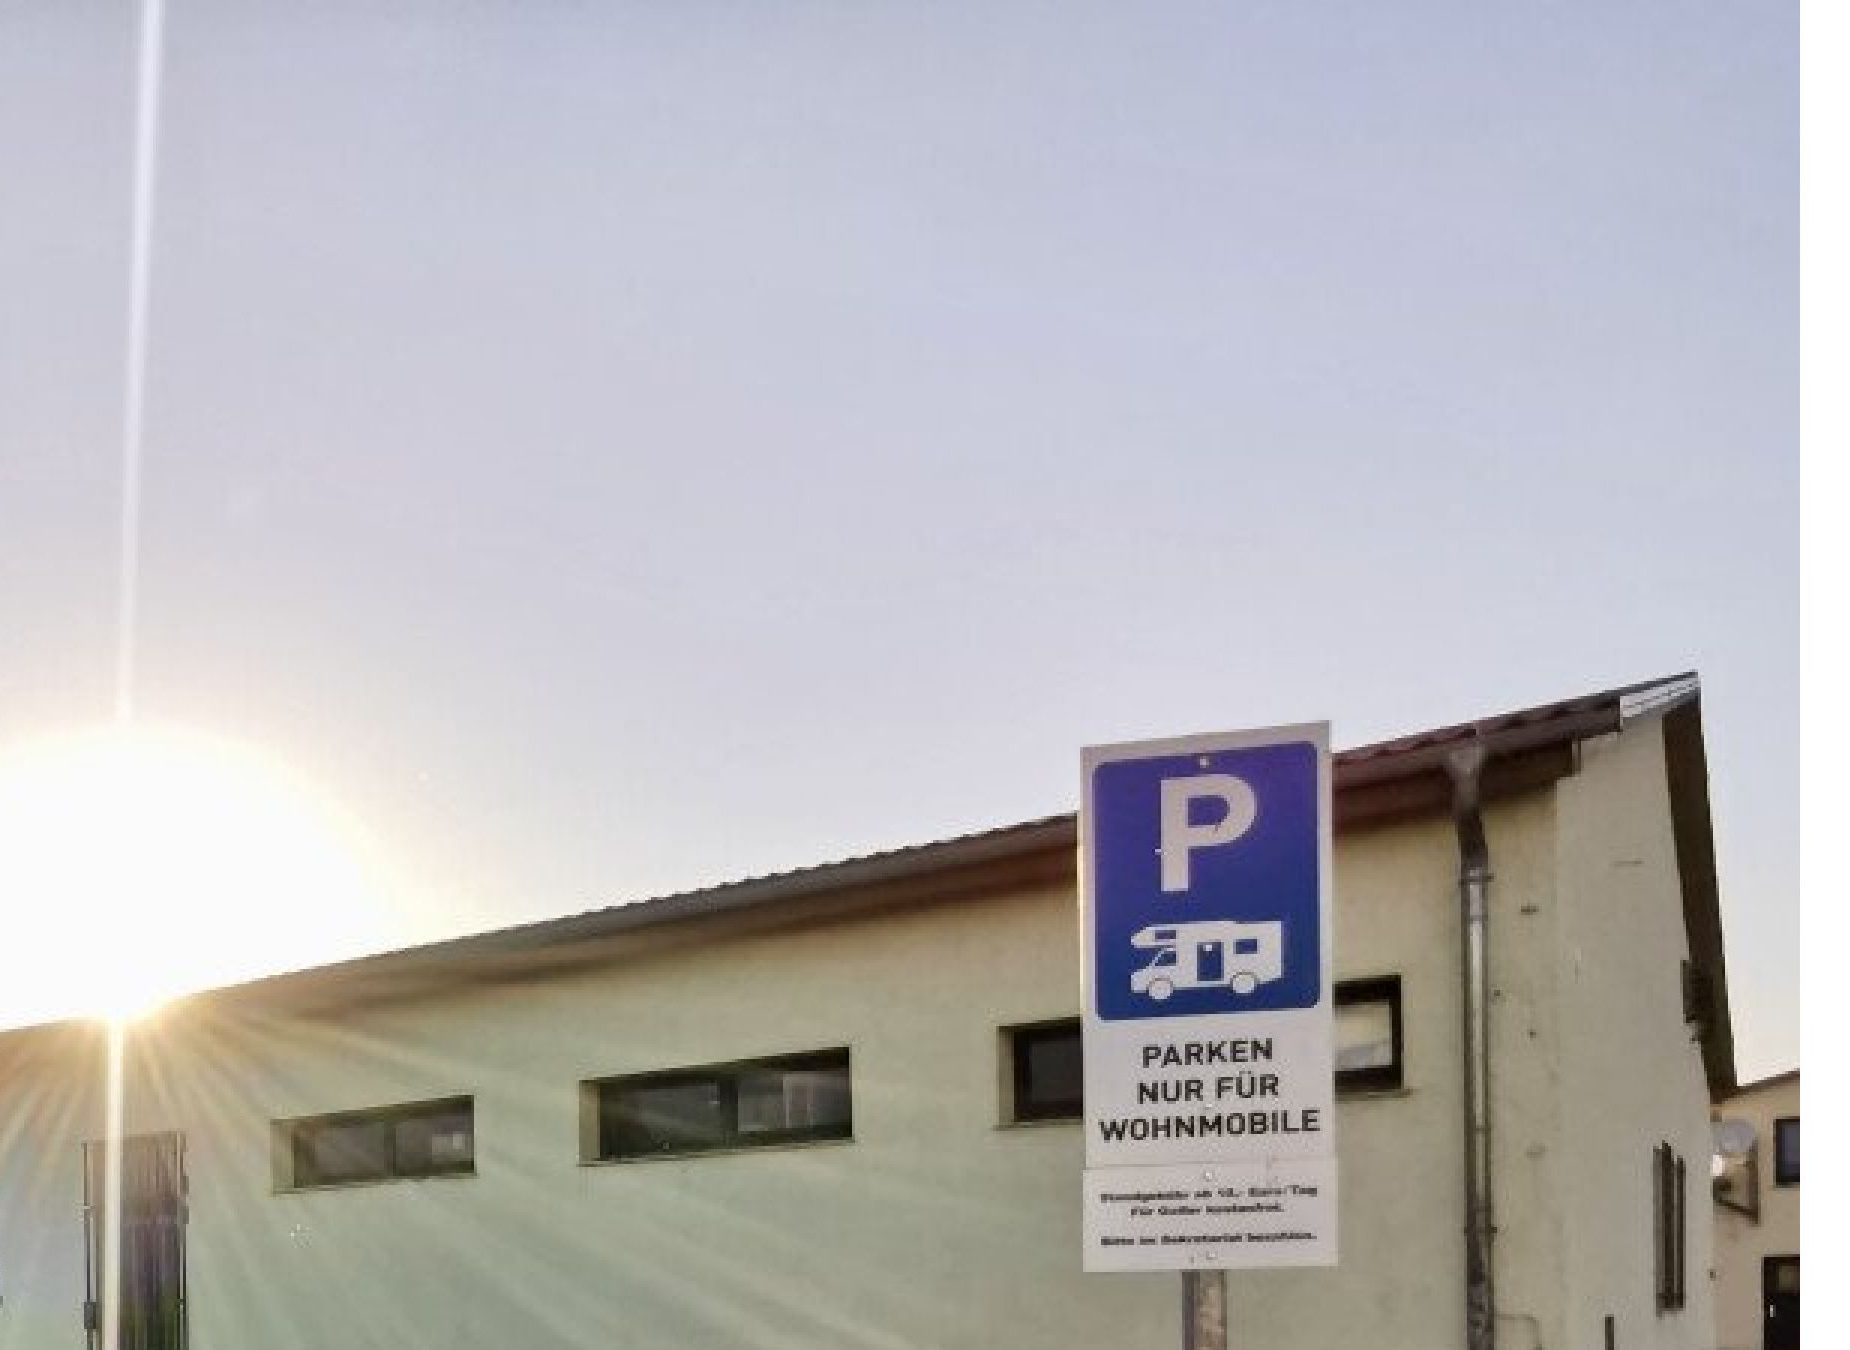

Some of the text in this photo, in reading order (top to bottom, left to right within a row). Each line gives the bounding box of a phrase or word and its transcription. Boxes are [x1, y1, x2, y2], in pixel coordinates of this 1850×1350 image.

[1161, 774, 1257, 892] P
[1142, 1037, 1273, 1068] PARKEN
[1138, 1071, 1280, 1105] NUR FÜR
[1098, 1109, 1322, 1143] WOHNMOBILE
